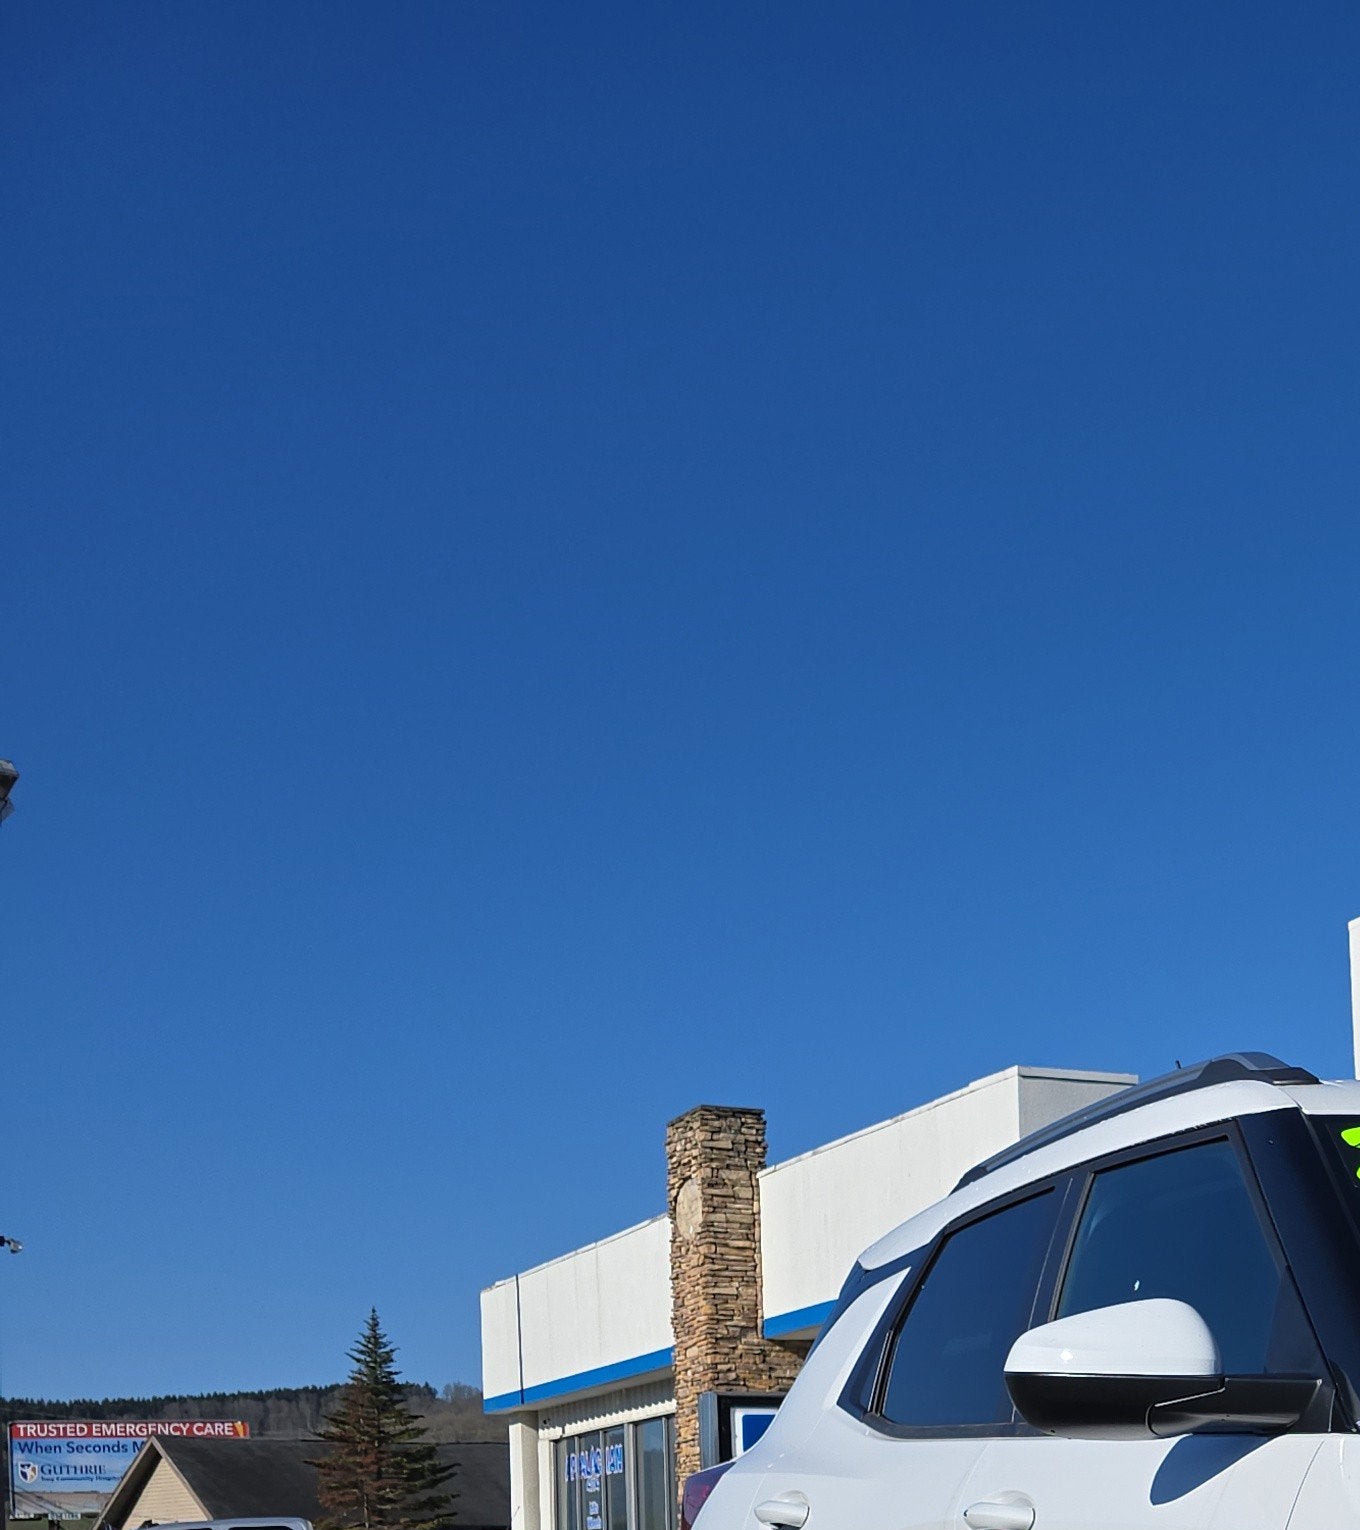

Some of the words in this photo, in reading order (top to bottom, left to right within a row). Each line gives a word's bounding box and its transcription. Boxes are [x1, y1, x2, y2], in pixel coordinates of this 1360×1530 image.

[17, 1423, 88, 1437] TRUSTED
[193, 1422, 234, 1436] CARE
[17, 1441, 62, 1454] When
[66, 1440, 128, 1454] Seconds
